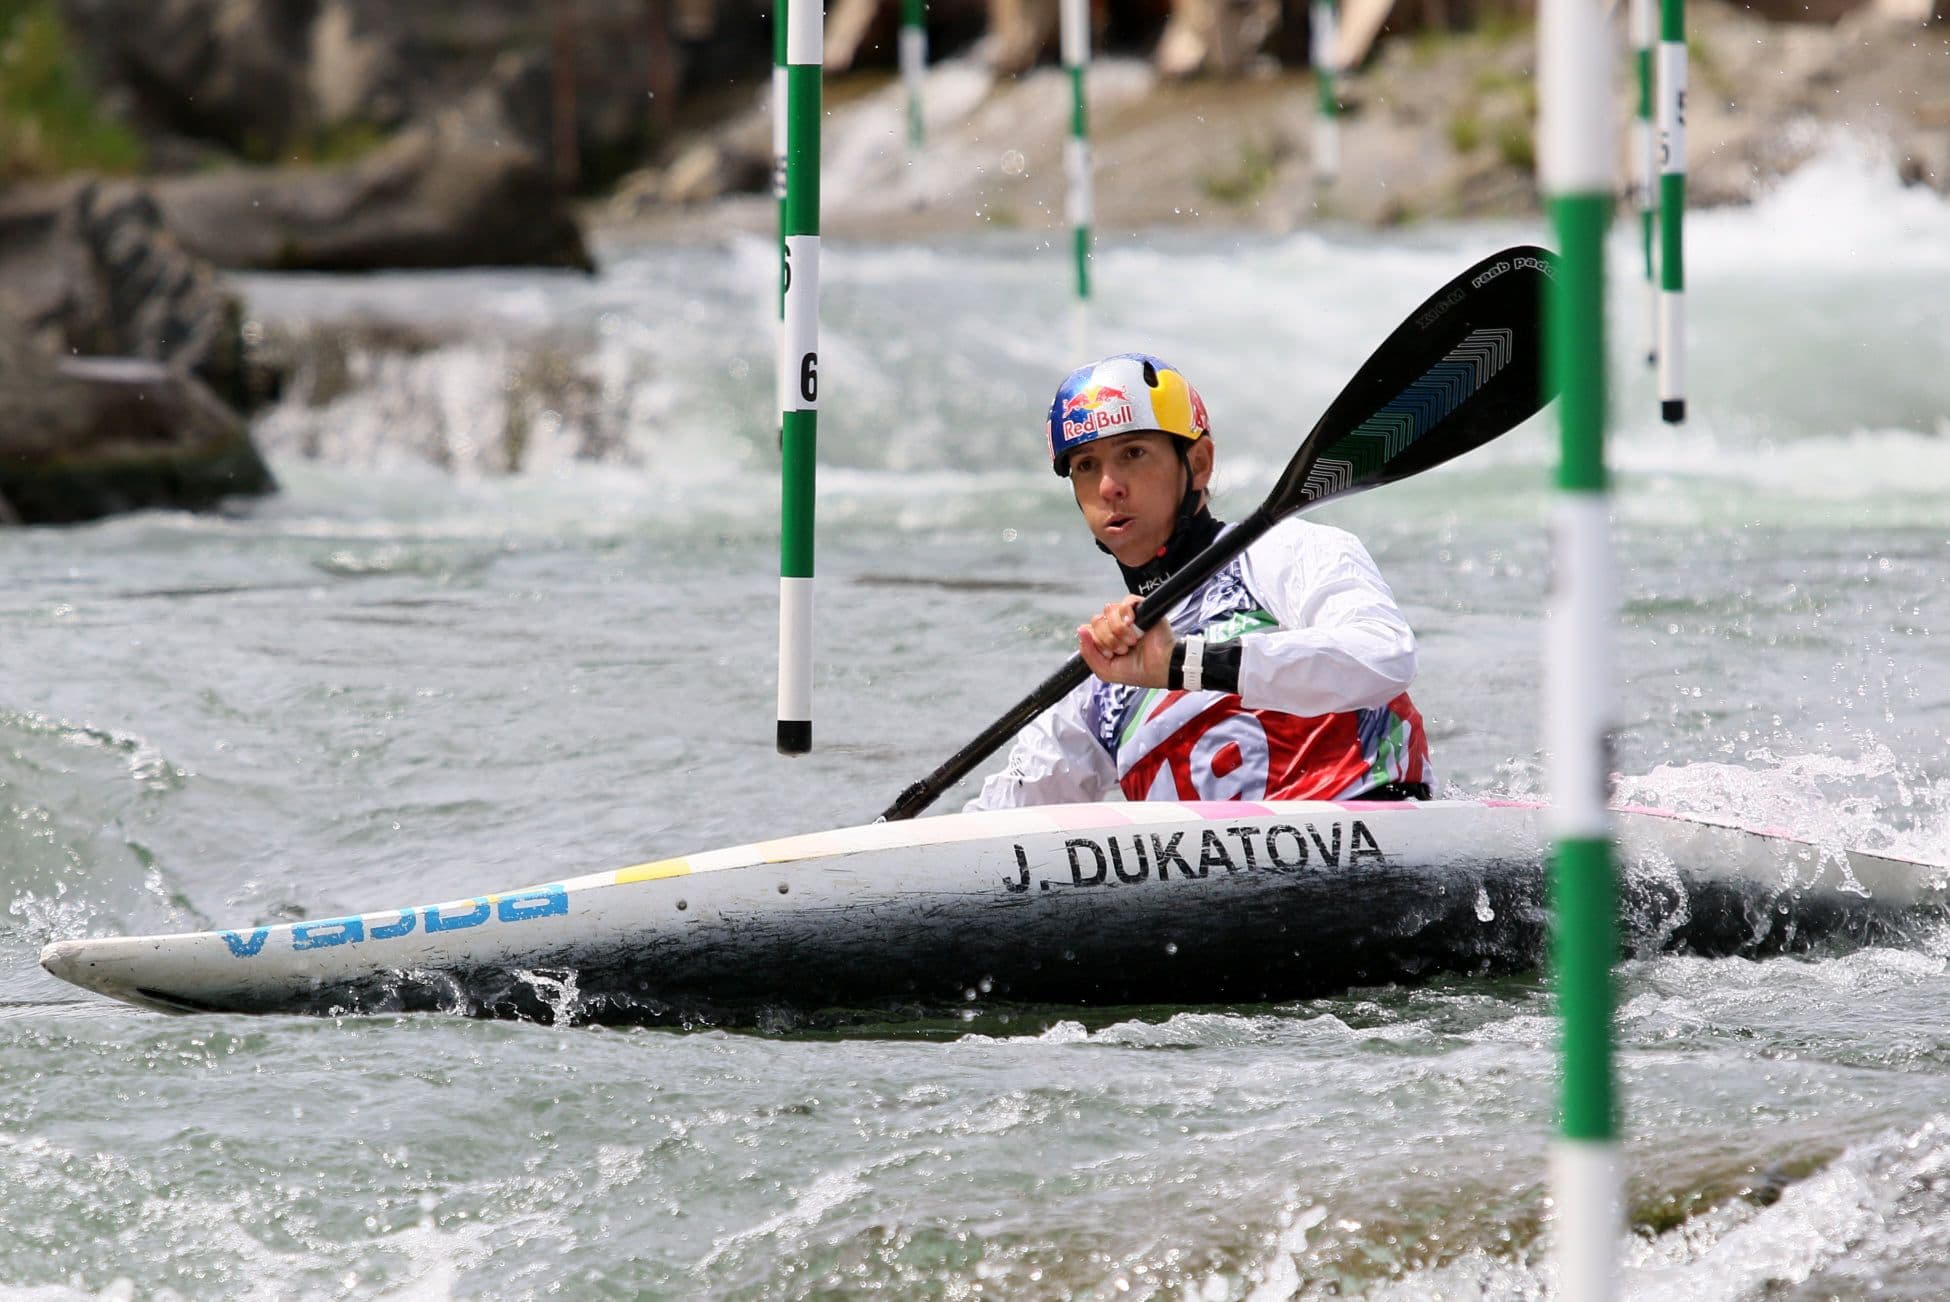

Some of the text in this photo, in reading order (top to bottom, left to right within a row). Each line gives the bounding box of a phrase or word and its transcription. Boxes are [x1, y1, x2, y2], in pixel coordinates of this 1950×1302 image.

[1472, 261, 1511, 289] raab
[800, 352, 818, 402] 6
[1063, 405, 1133, 441] Red Bull
[1002, 820, 1388, 893] J. DUKATOVA
